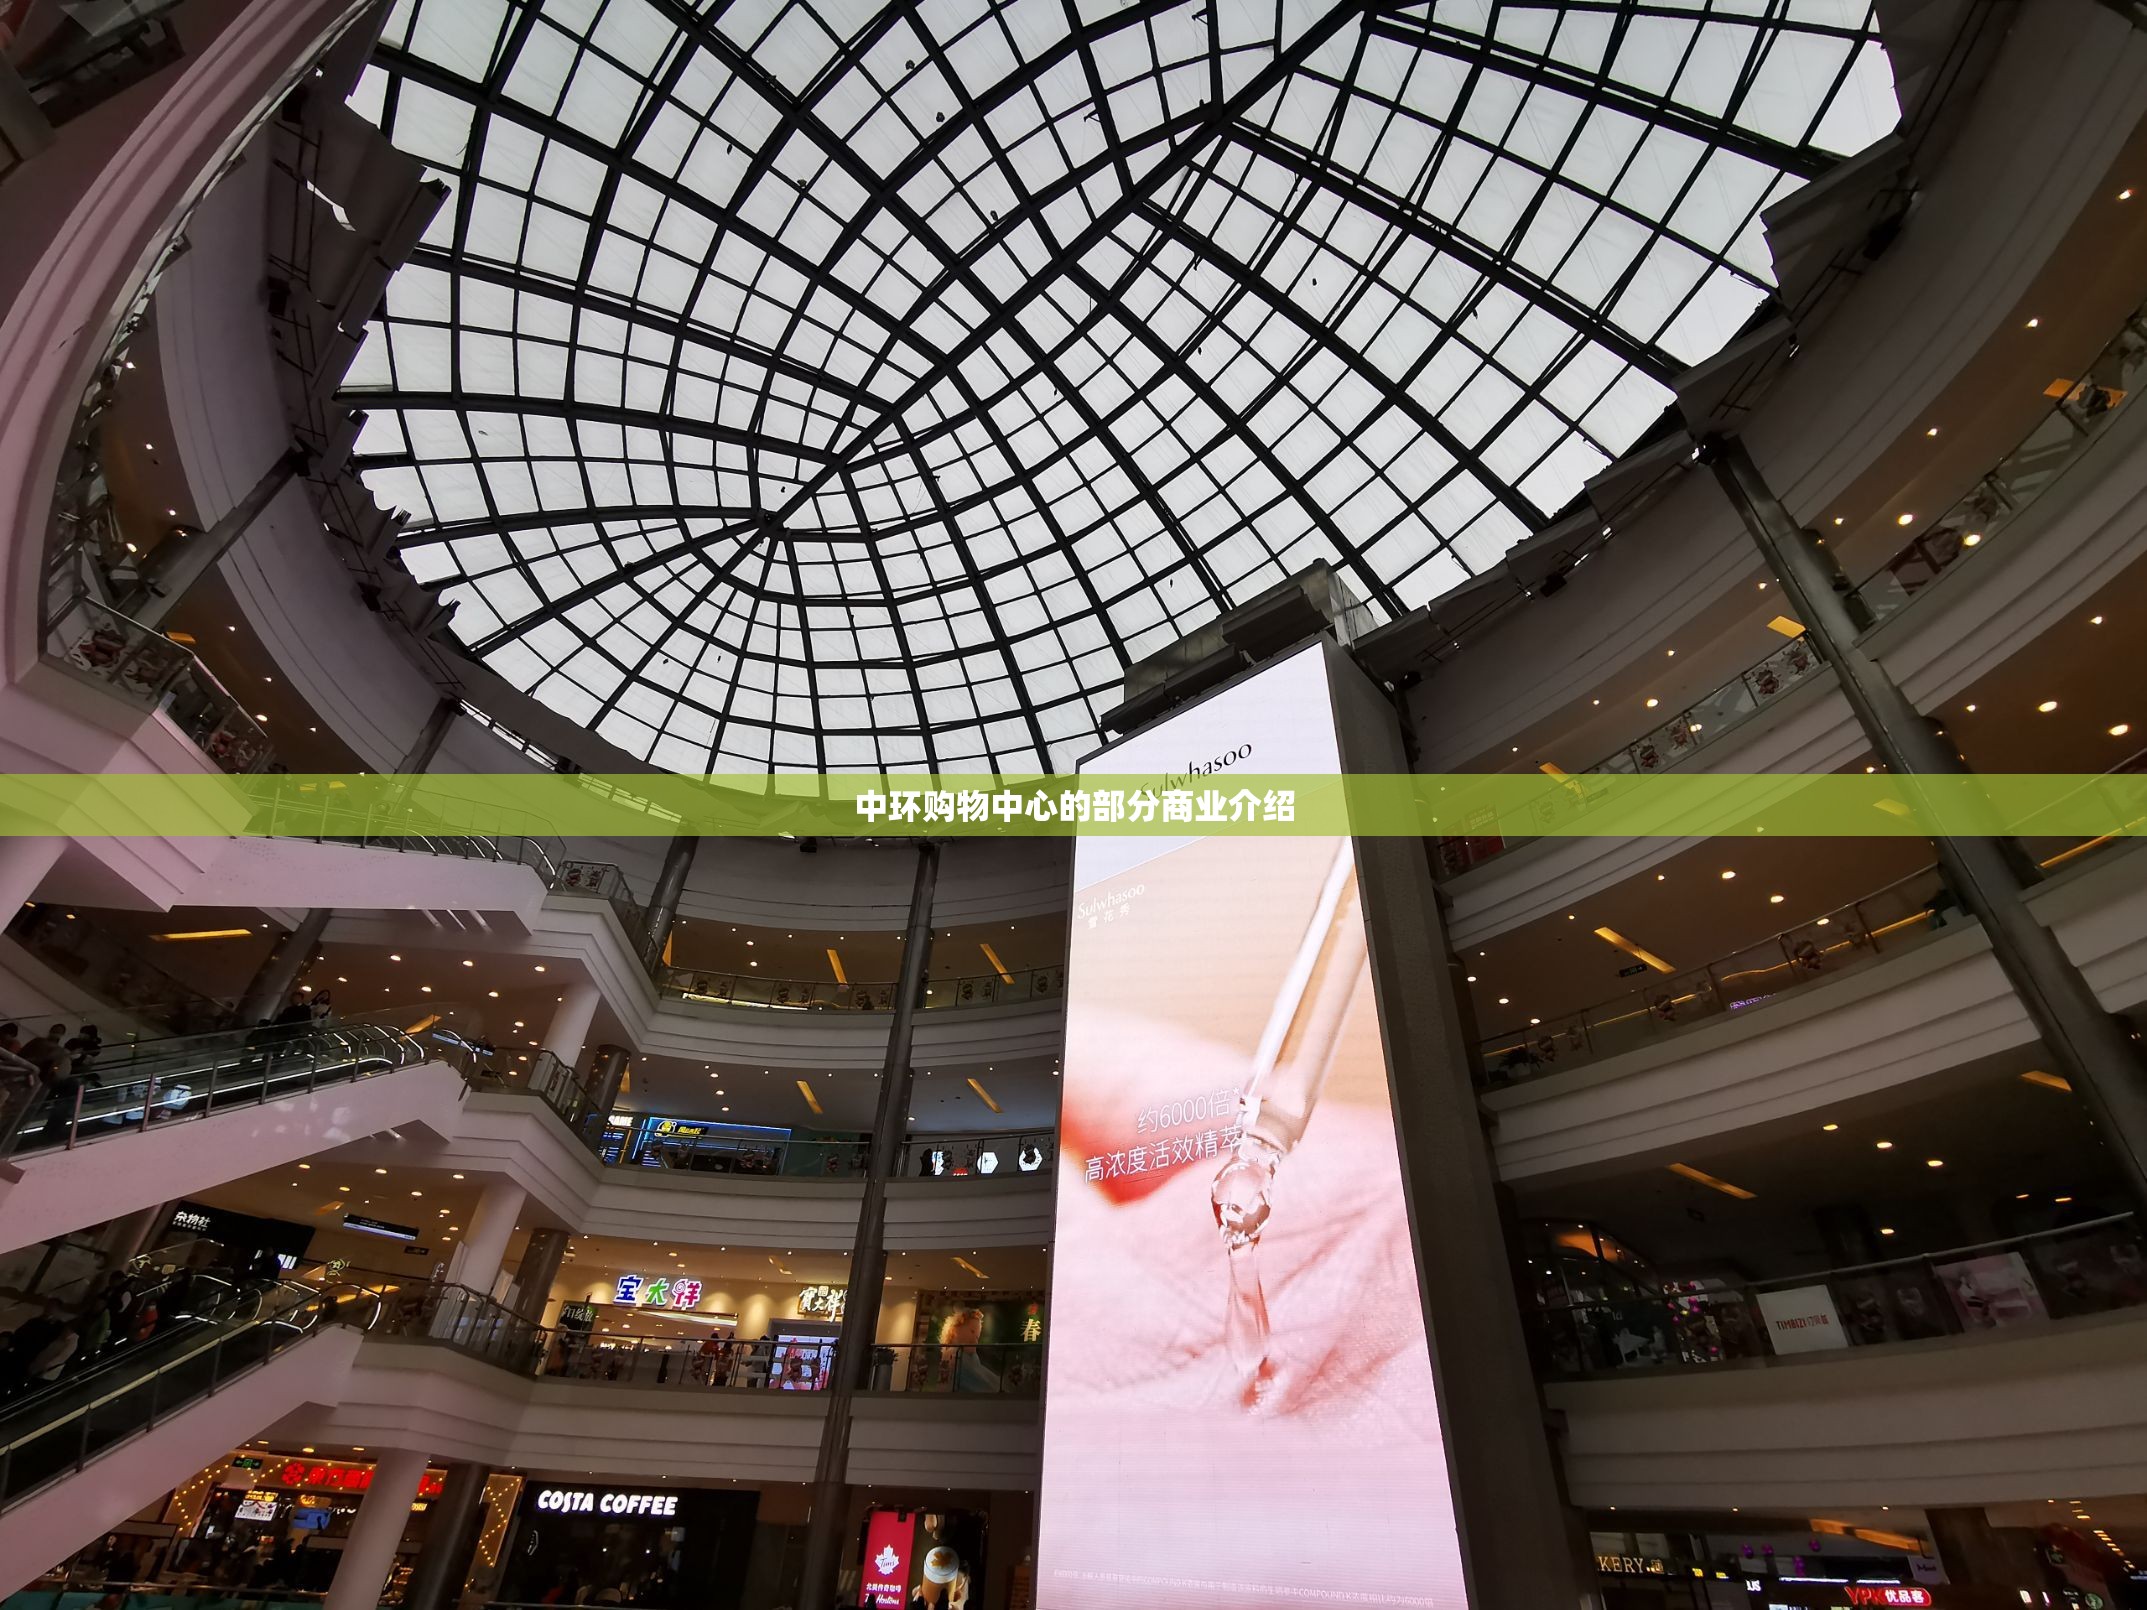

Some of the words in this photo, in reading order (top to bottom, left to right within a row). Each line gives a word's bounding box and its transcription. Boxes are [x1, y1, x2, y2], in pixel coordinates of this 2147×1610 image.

[1077, 884, 1145, 919] Sulwhasoo
[1087, 902, 1131, 930] 雪花秀
[1084, 1124, 1243, 1184] 高浓度活效精萃
[613, 1274, 703, 1308] 宝大祥
[1023, 1318, 1042, 1342] 春
[538, 1490, 594, 1513] COSTA
[600, 1493, 678, 1515] COFFEE
[1885, 1589, 1925, 1604] 优品客
